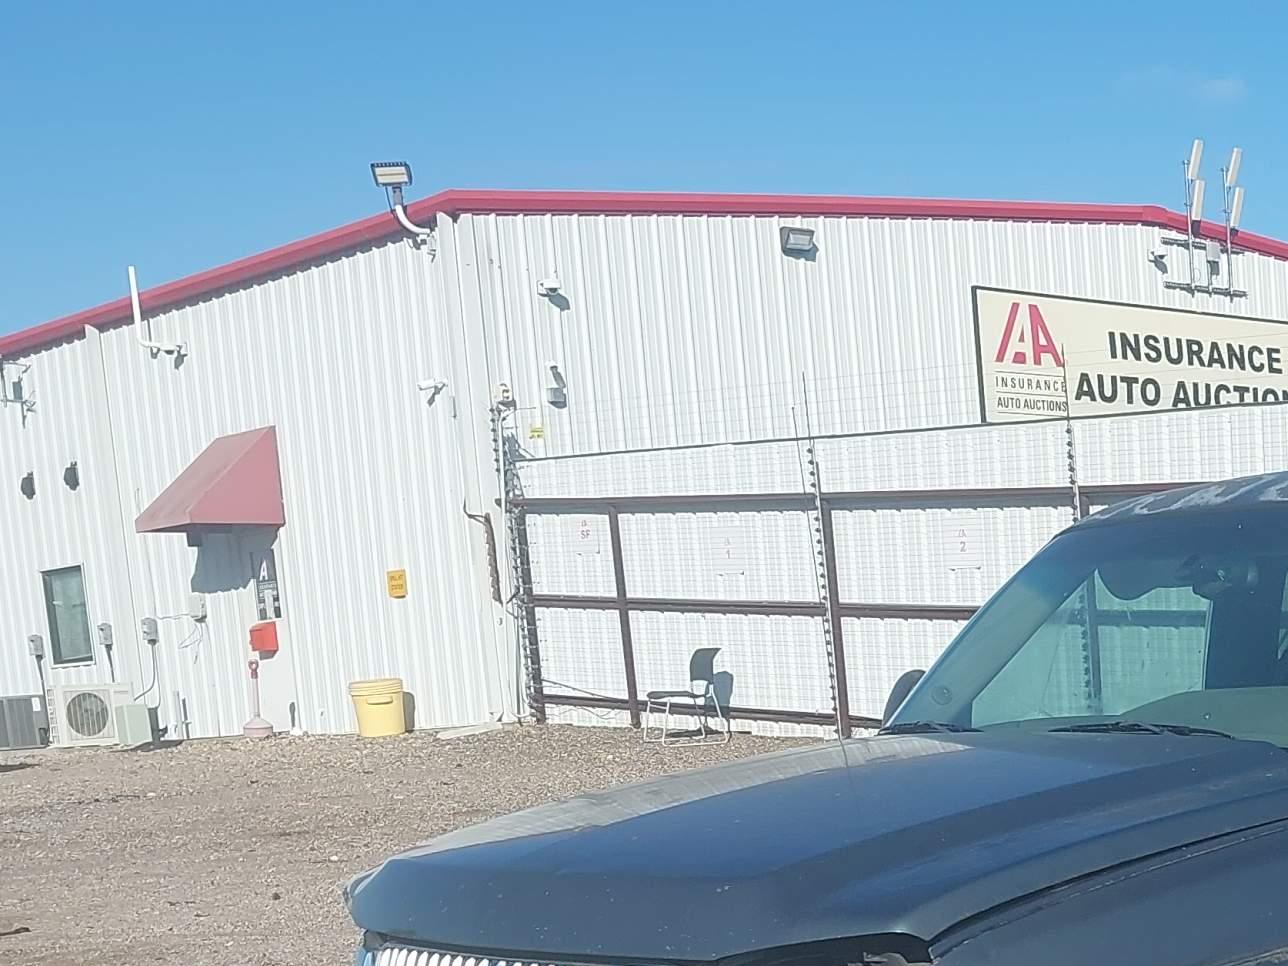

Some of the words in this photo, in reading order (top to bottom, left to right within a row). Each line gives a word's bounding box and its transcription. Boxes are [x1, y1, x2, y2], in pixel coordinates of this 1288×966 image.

[1108, 331, 1283, 374] INSURANCE
[995, 376, 1067, 393] INSURANCE
[1075, 373, 1161, 406] AUTO
[997, 397, 1021, 409] AUTO
[1023, 399, 1068, 412] AUCTIONS
[959, 541, 967, 552] 2
